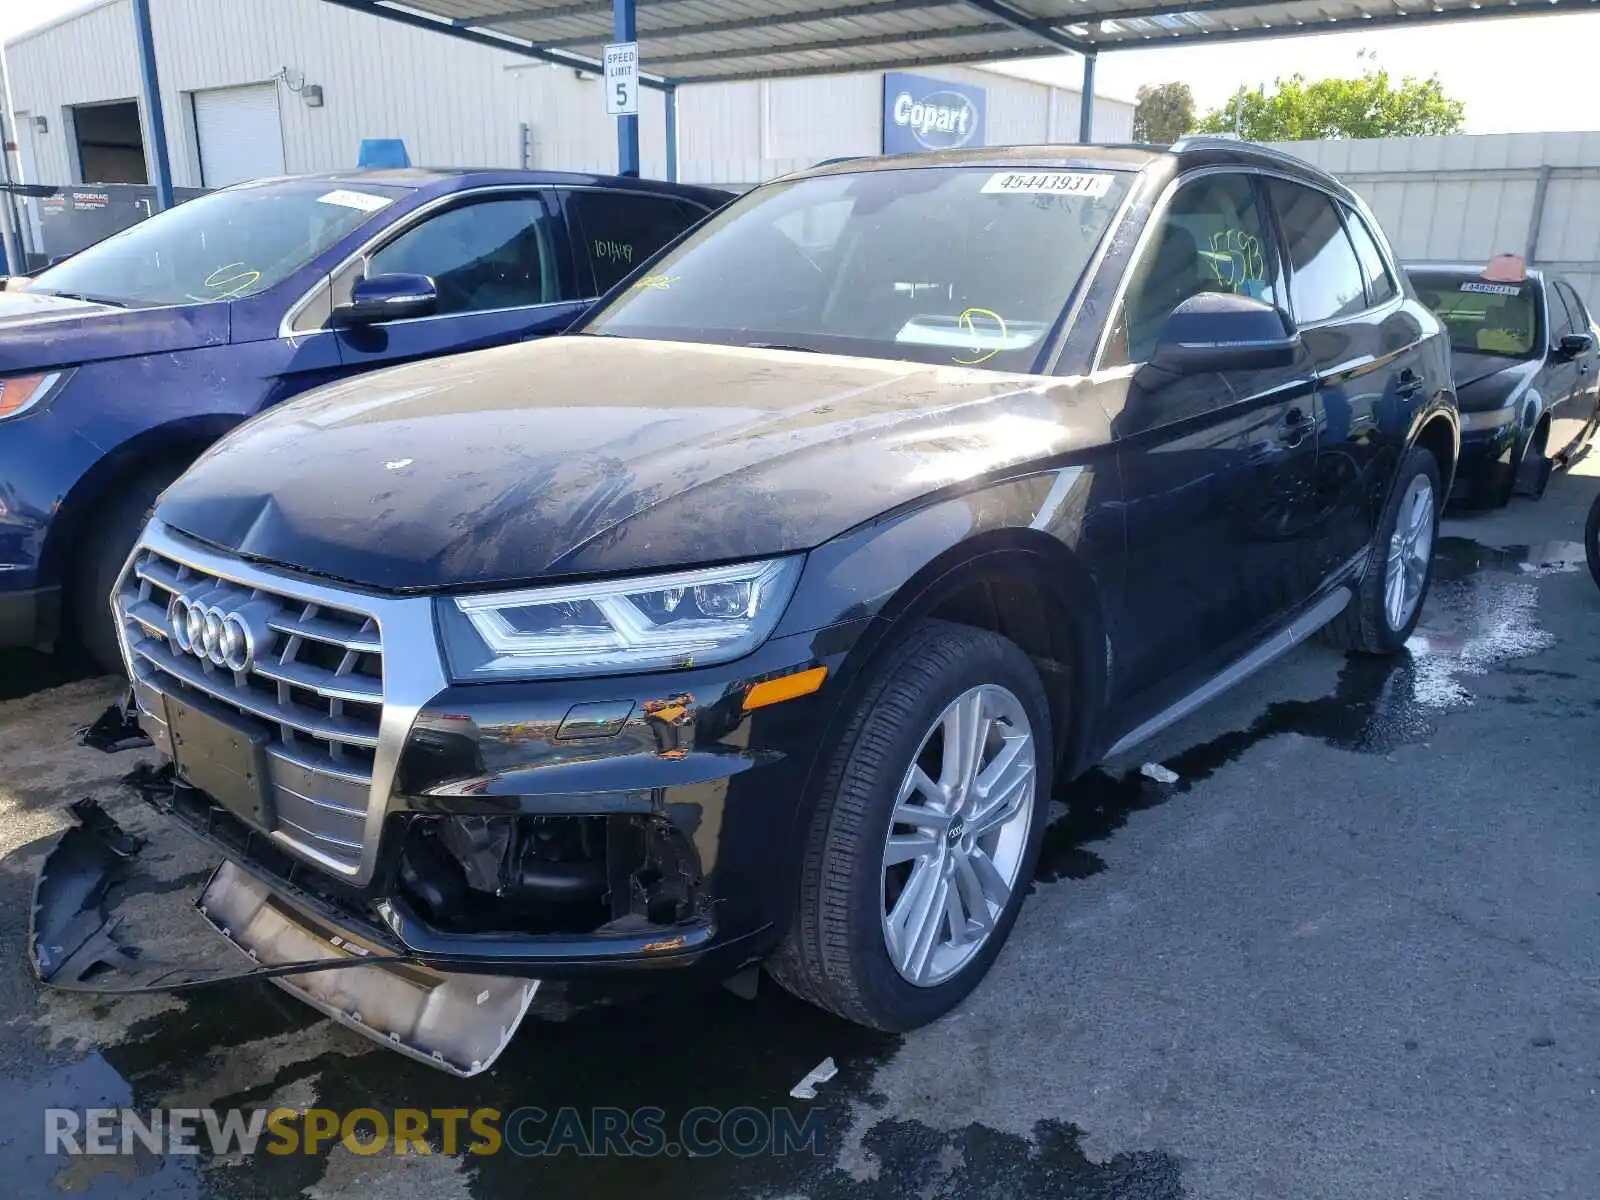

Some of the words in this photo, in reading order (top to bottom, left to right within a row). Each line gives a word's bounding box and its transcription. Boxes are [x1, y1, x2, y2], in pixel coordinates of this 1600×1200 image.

[607, 51, 634, 64] SPEED
[610, 66, 632, 77] LIMIT
[616, 82, 628, 106] 5
[894, 92, 970, 135] Copart
